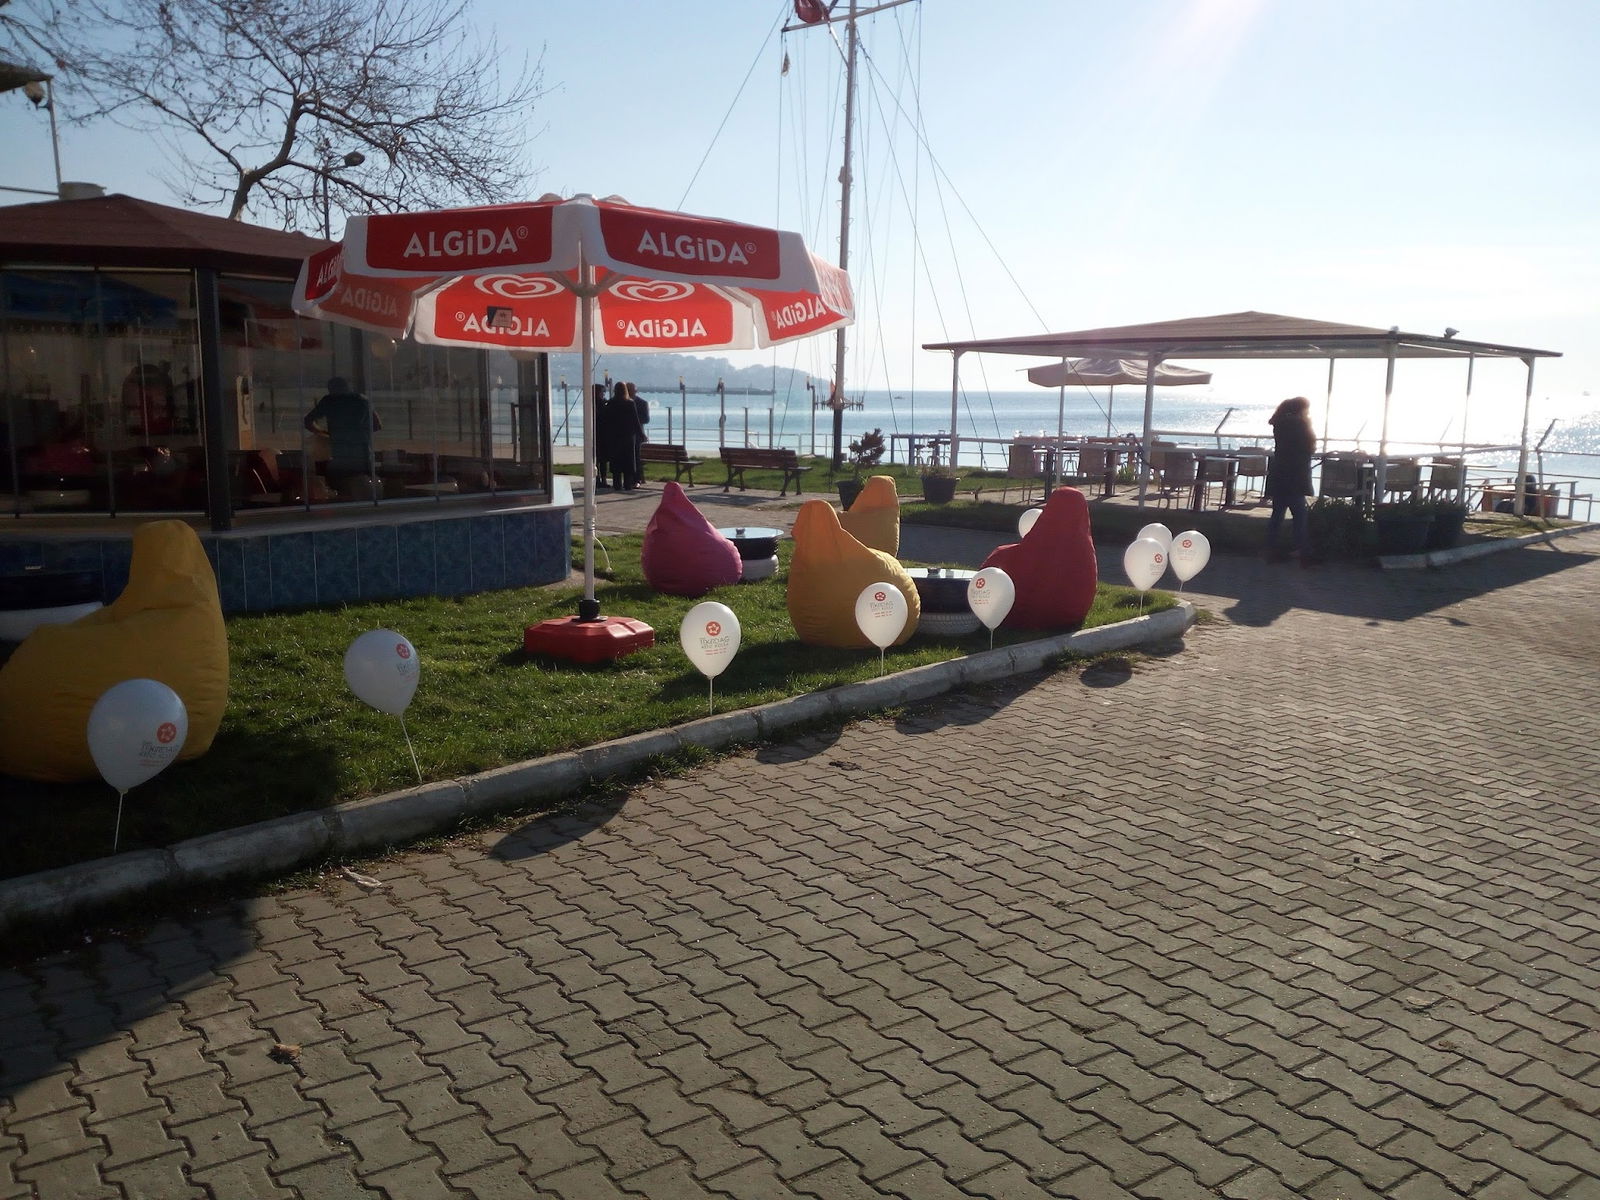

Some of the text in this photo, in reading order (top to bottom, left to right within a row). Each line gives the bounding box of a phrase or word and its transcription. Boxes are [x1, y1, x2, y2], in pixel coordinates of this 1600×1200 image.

[403, 226, 518, 258] ALGiDA
[637, 229, 749, 266] ALGiDA
[316, 252, 343, 287] ALGi
